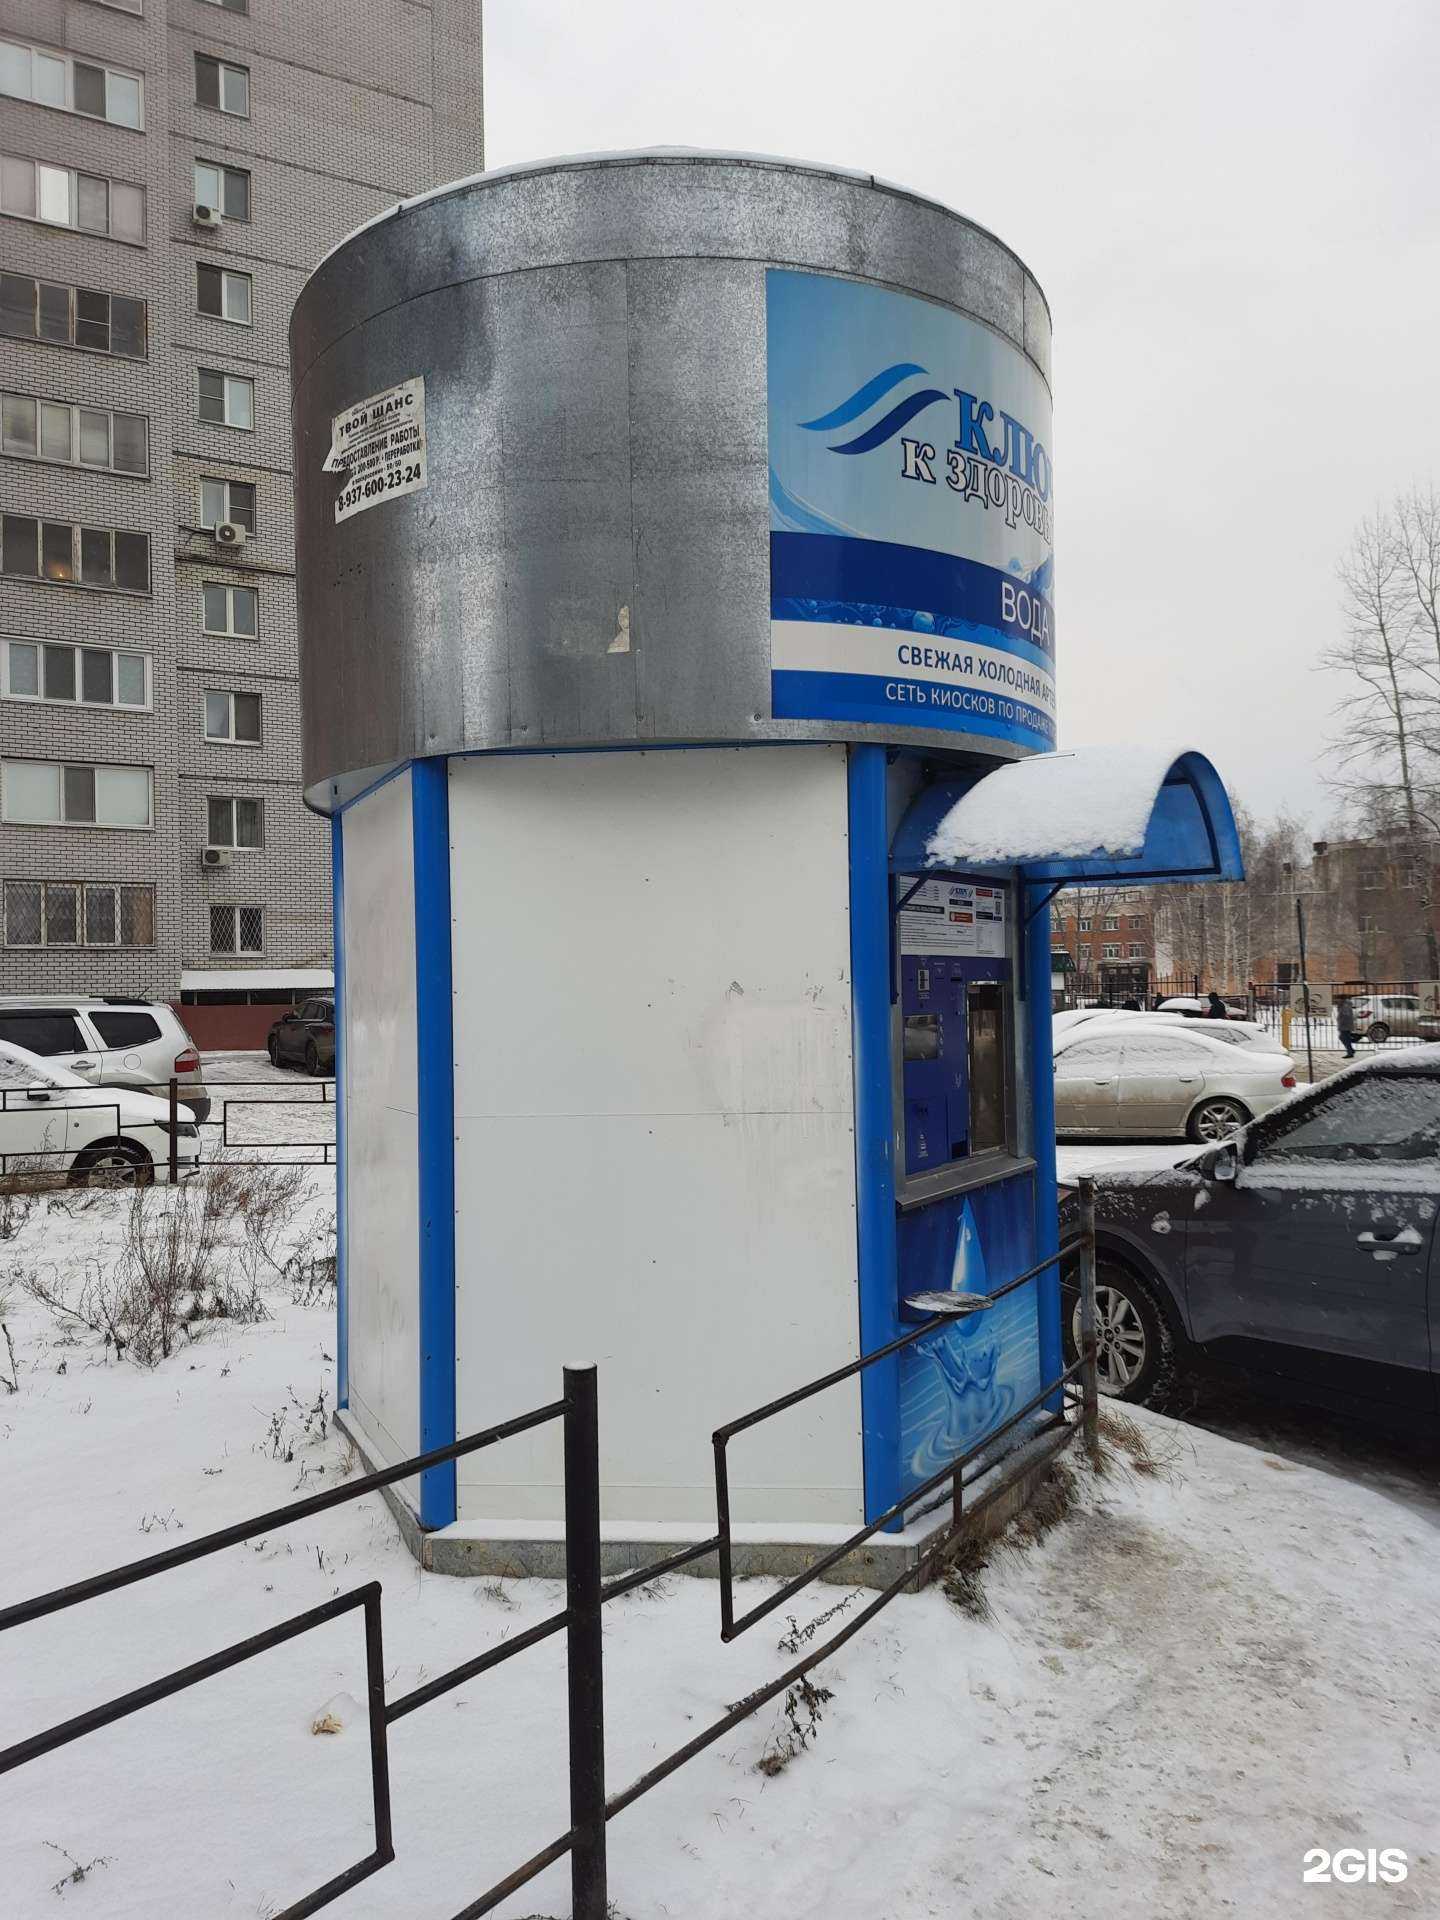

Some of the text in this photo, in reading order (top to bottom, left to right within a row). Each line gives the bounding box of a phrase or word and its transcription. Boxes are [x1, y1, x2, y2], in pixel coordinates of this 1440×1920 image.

[339, 411, 368, 437] ТВОЙ
[372, 393, 414, 419] ШАНС
[331, 436, 388, 469] ПРЕДОСТАВЛЕНИЕ
[390, 424, 420, 446] РАБОТЫ
[384, 440, 421, 462] ПЕРЕРАБОТКА
[954, 388, 1051, 502] КЛЮ
[338, 463, 422, 512] 8-937-600-23-24
[1001, 581, 1050, 647] ВОДА
[898, 644, 973, 675] СВЕЖАЯ
[978, 657, 1041, 696] ХОЛОДНАЯ
[885, 682, 927, 703] СЕТЬ
[931, 687, 996, 715] КИОСКОВ
[998, 700, 1014, 719] ПО
